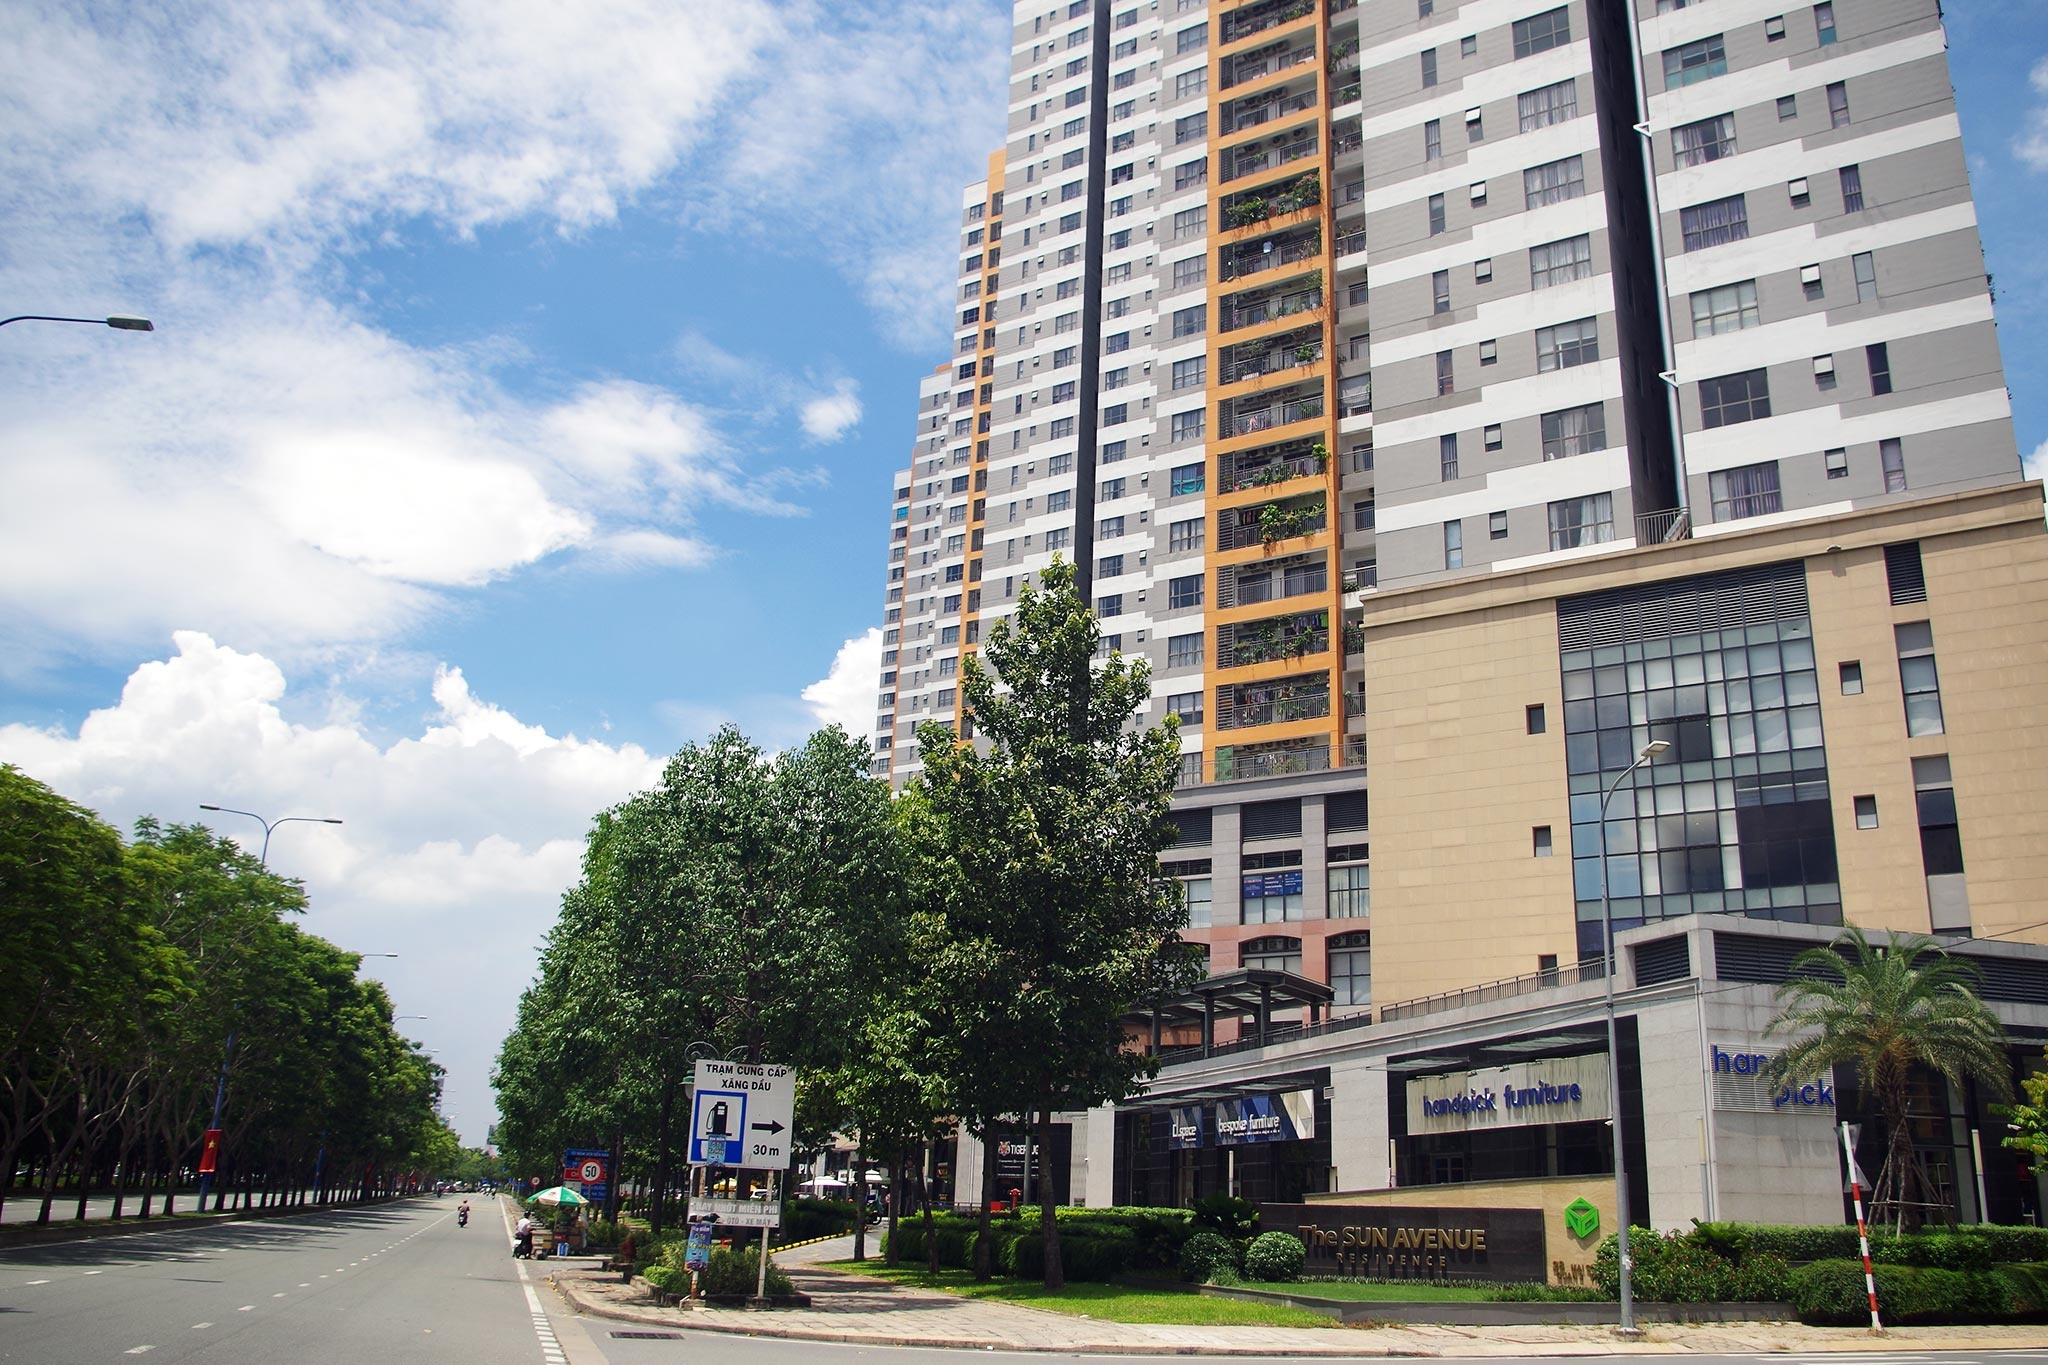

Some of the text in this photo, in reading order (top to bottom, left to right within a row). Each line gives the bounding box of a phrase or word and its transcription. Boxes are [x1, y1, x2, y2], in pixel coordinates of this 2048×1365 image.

[706, 1064, 787, 1078] TRẠM CUNG CẤP
[721, 1078, 749, 1090] XĂNG
[1423, 1080, 1582, 1119] handpick furniture
[1218, 1116, 1248, 1135] bespoke
[1249, 1114, 1280, 1130] furniture
[752, 1144, 779, 1156] 30 m
[585, 1165, 597, 1178] 50
[1298, 1225, 1487, 1250] The SUN AVENUE
[1335, 1252, 1446, 1267] RESIDENCE
